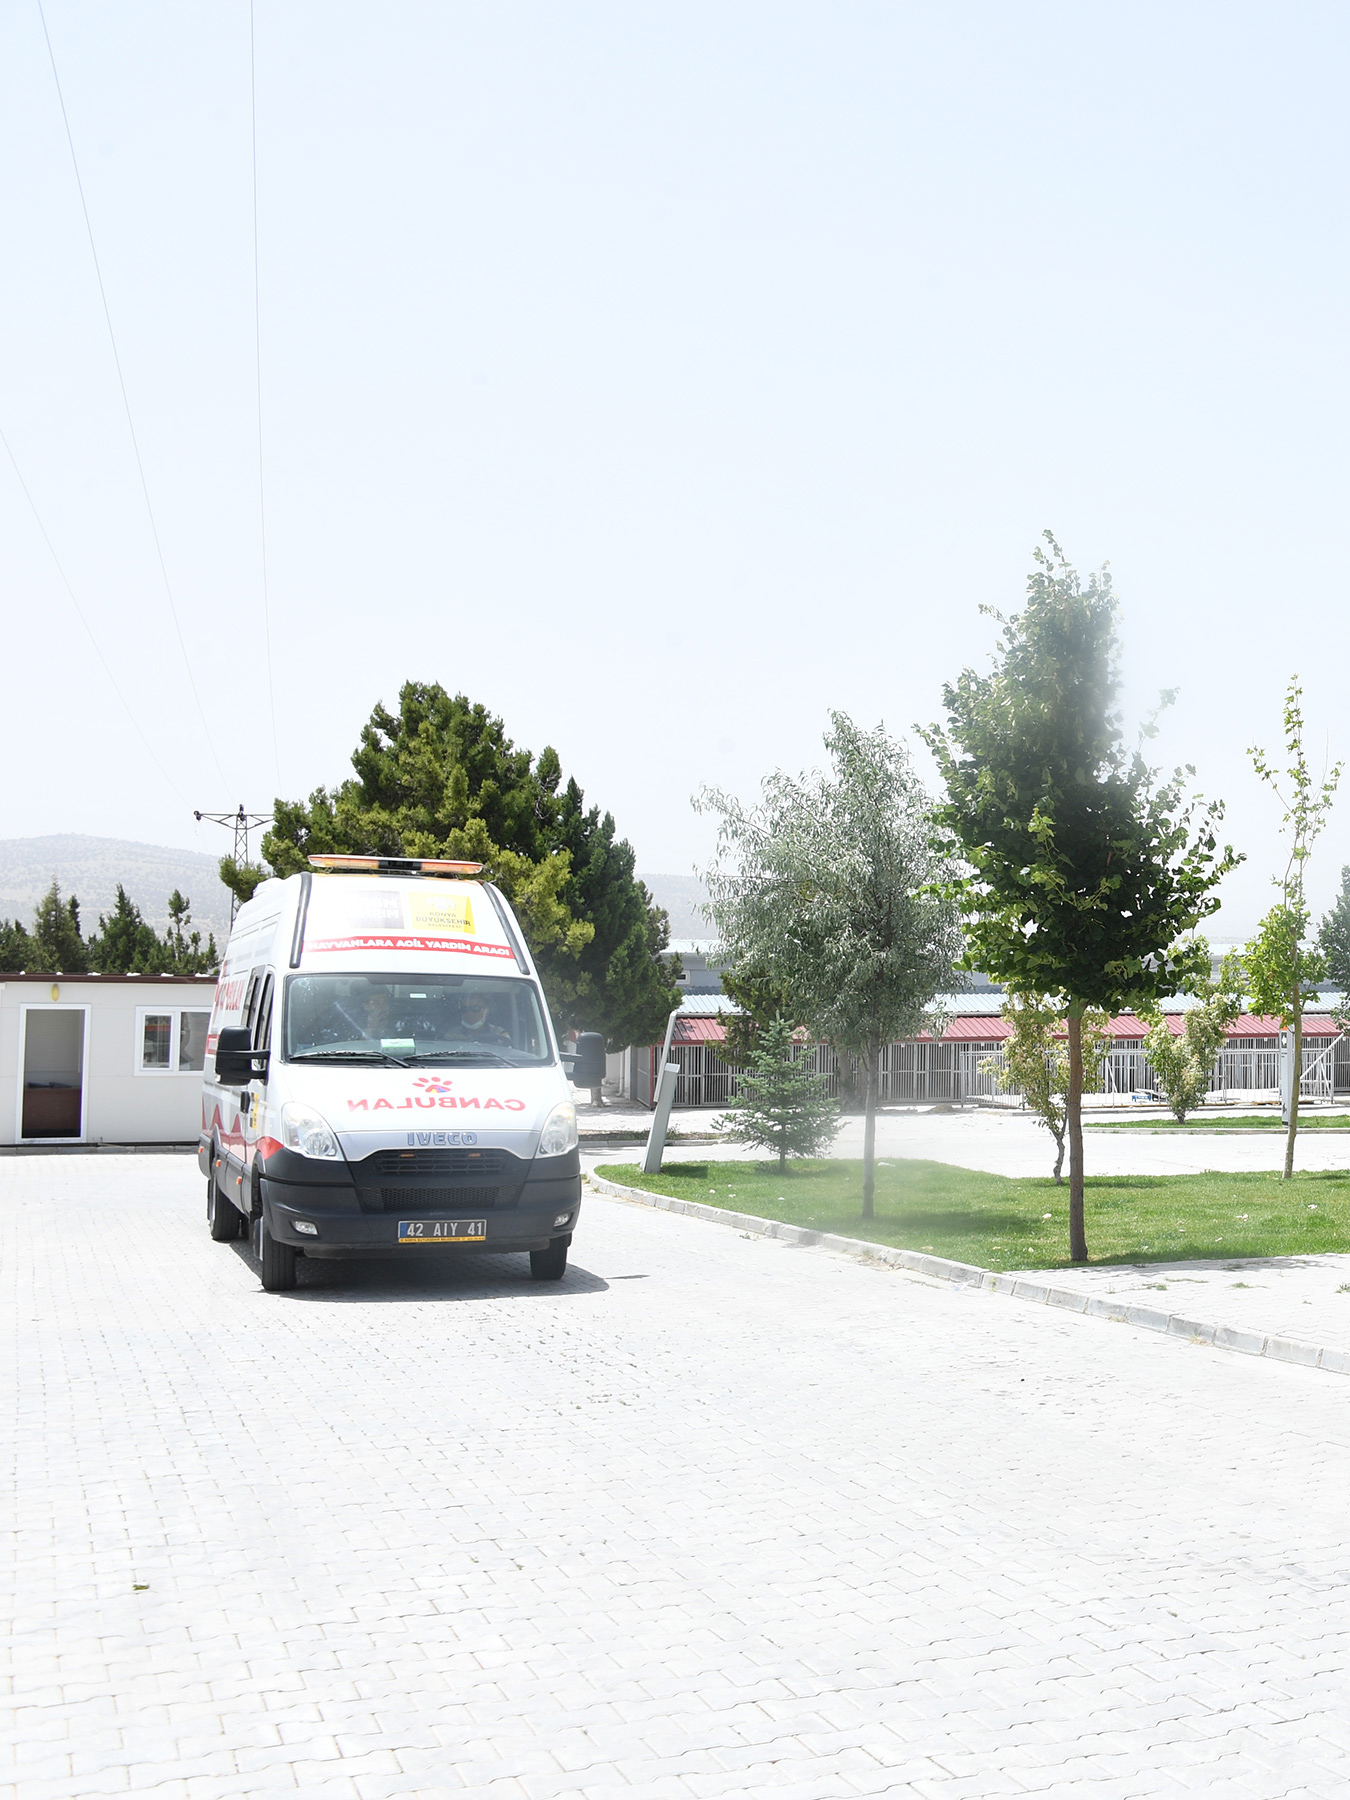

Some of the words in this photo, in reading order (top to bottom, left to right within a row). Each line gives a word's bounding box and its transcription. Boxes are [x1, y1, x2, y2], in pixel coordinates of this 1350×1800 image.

[309, 938, 394, 950] HAYVANLARA
[396, 938, 424, 949] ACİL
[425, 940, 471, 951] YARDIM
[473, 945, 510, 956] ARACI
[407, 1132, 478, 1146] IVECO
[407, 1223, 424, 1236] 42
[433, 1222, 458, 1236] AIY
[467, 1222, 482, 1236] 41
